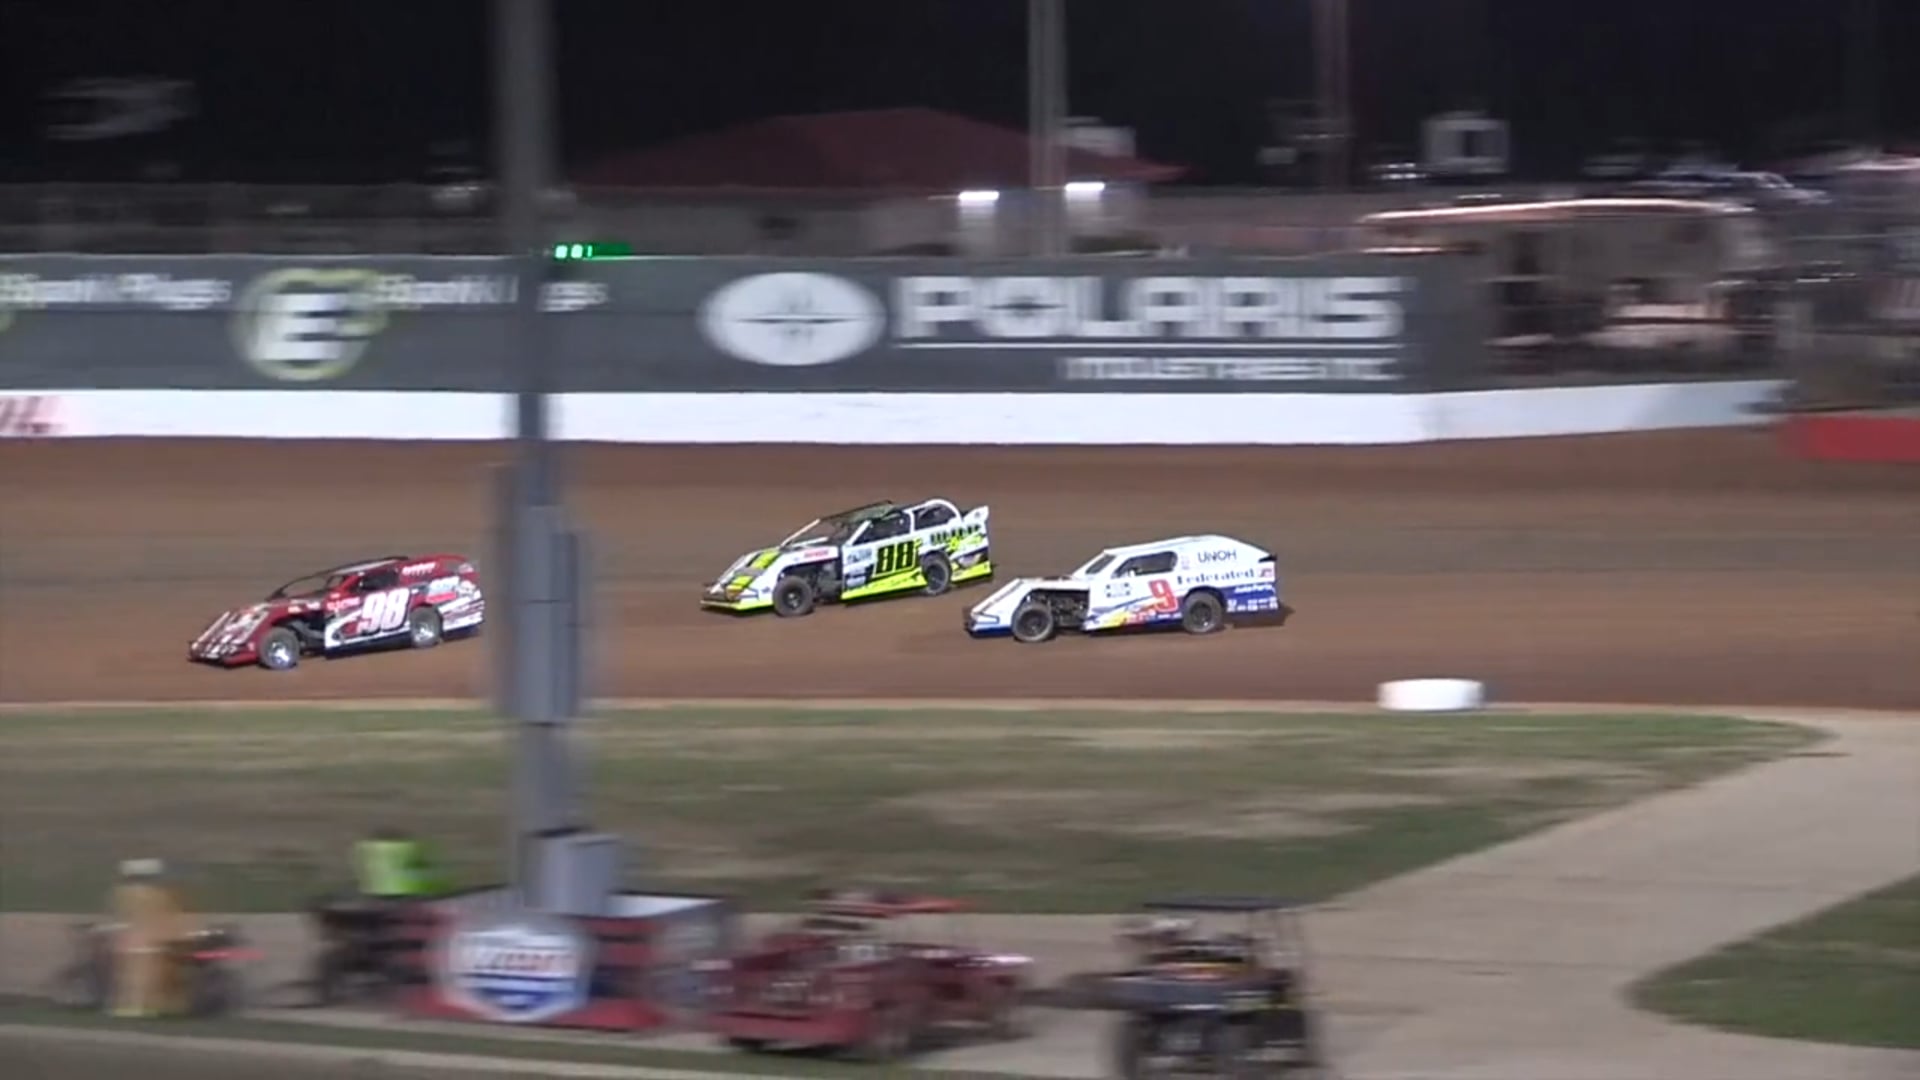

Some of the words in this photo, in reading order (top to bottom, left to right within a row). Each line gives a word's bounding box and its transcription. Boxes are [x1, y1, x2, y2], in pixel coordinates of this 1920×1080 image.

[897, 276, 1403, 338] POLARIS
[874, 540, 917, 576] 88
[1197, 549, 1238, 564] UNOH
[361, 587, 410, 634] 98
[1148, 578, 1179, 613] 9
